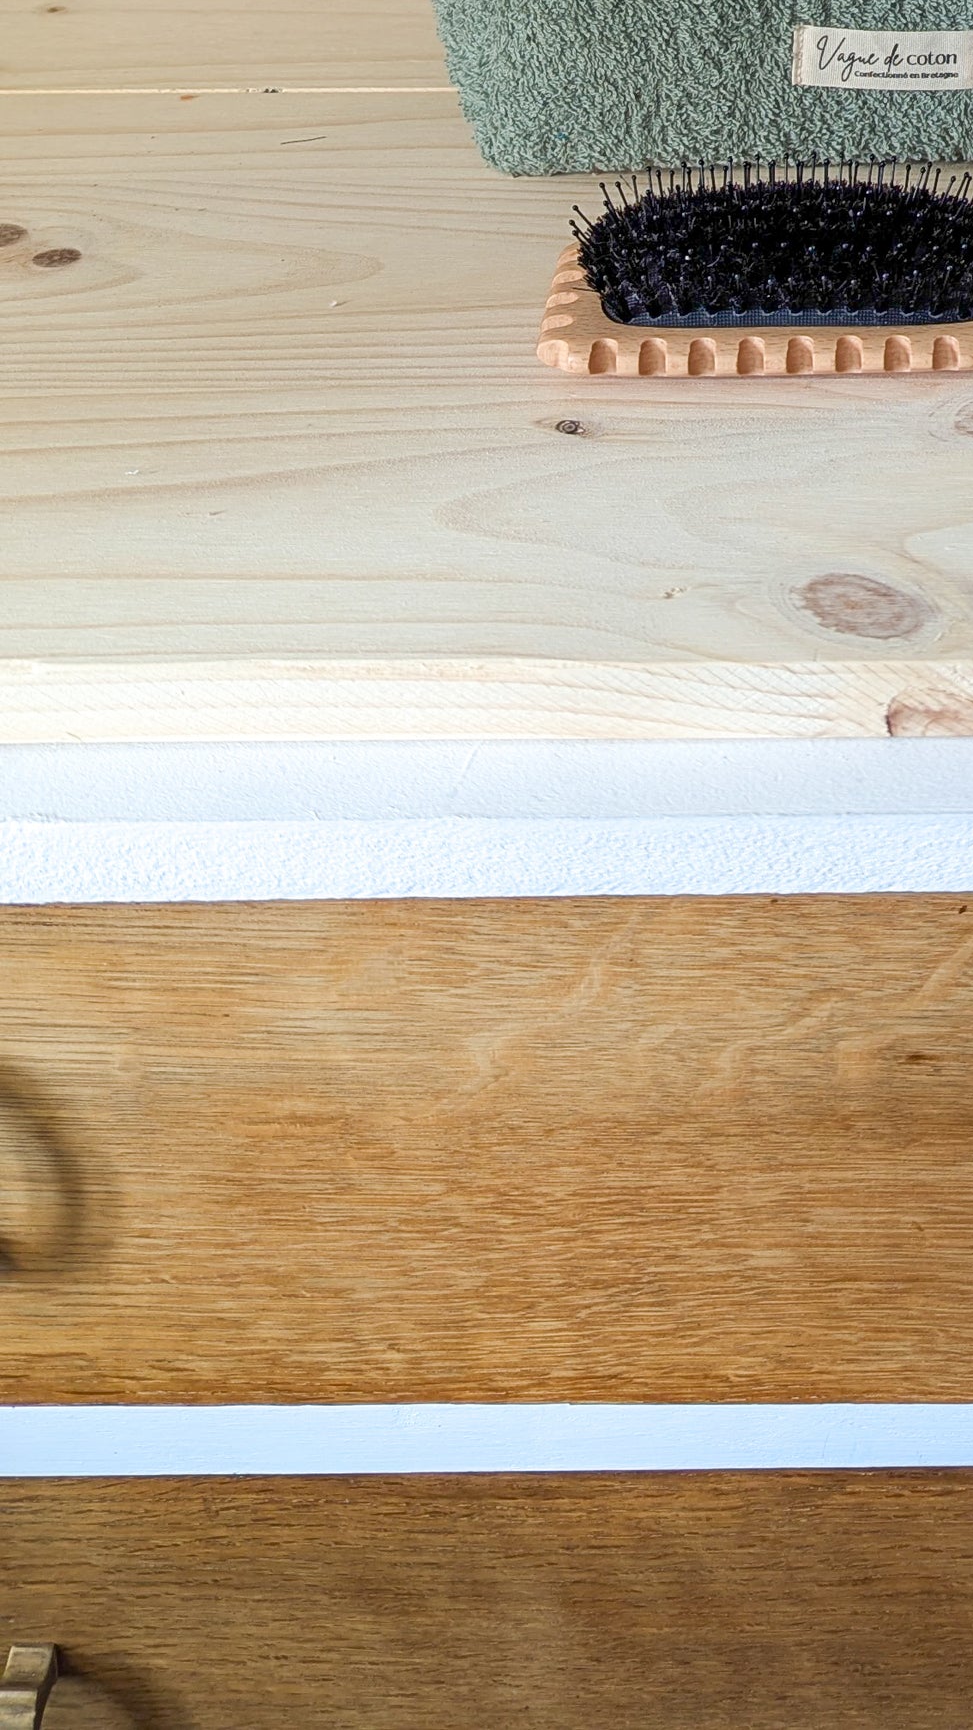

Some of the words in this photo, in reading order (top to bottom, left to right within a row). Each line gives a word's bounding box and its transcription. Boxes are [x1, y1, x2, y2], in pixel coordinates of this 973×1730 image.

[816, 34, 880, 82] Vague
[884, 43, 904, 73] de
[906, 51, 957, 66] coton
[854, 70, 908, 79] Confectionné
[921, 71, 959, 80] Bretagne
